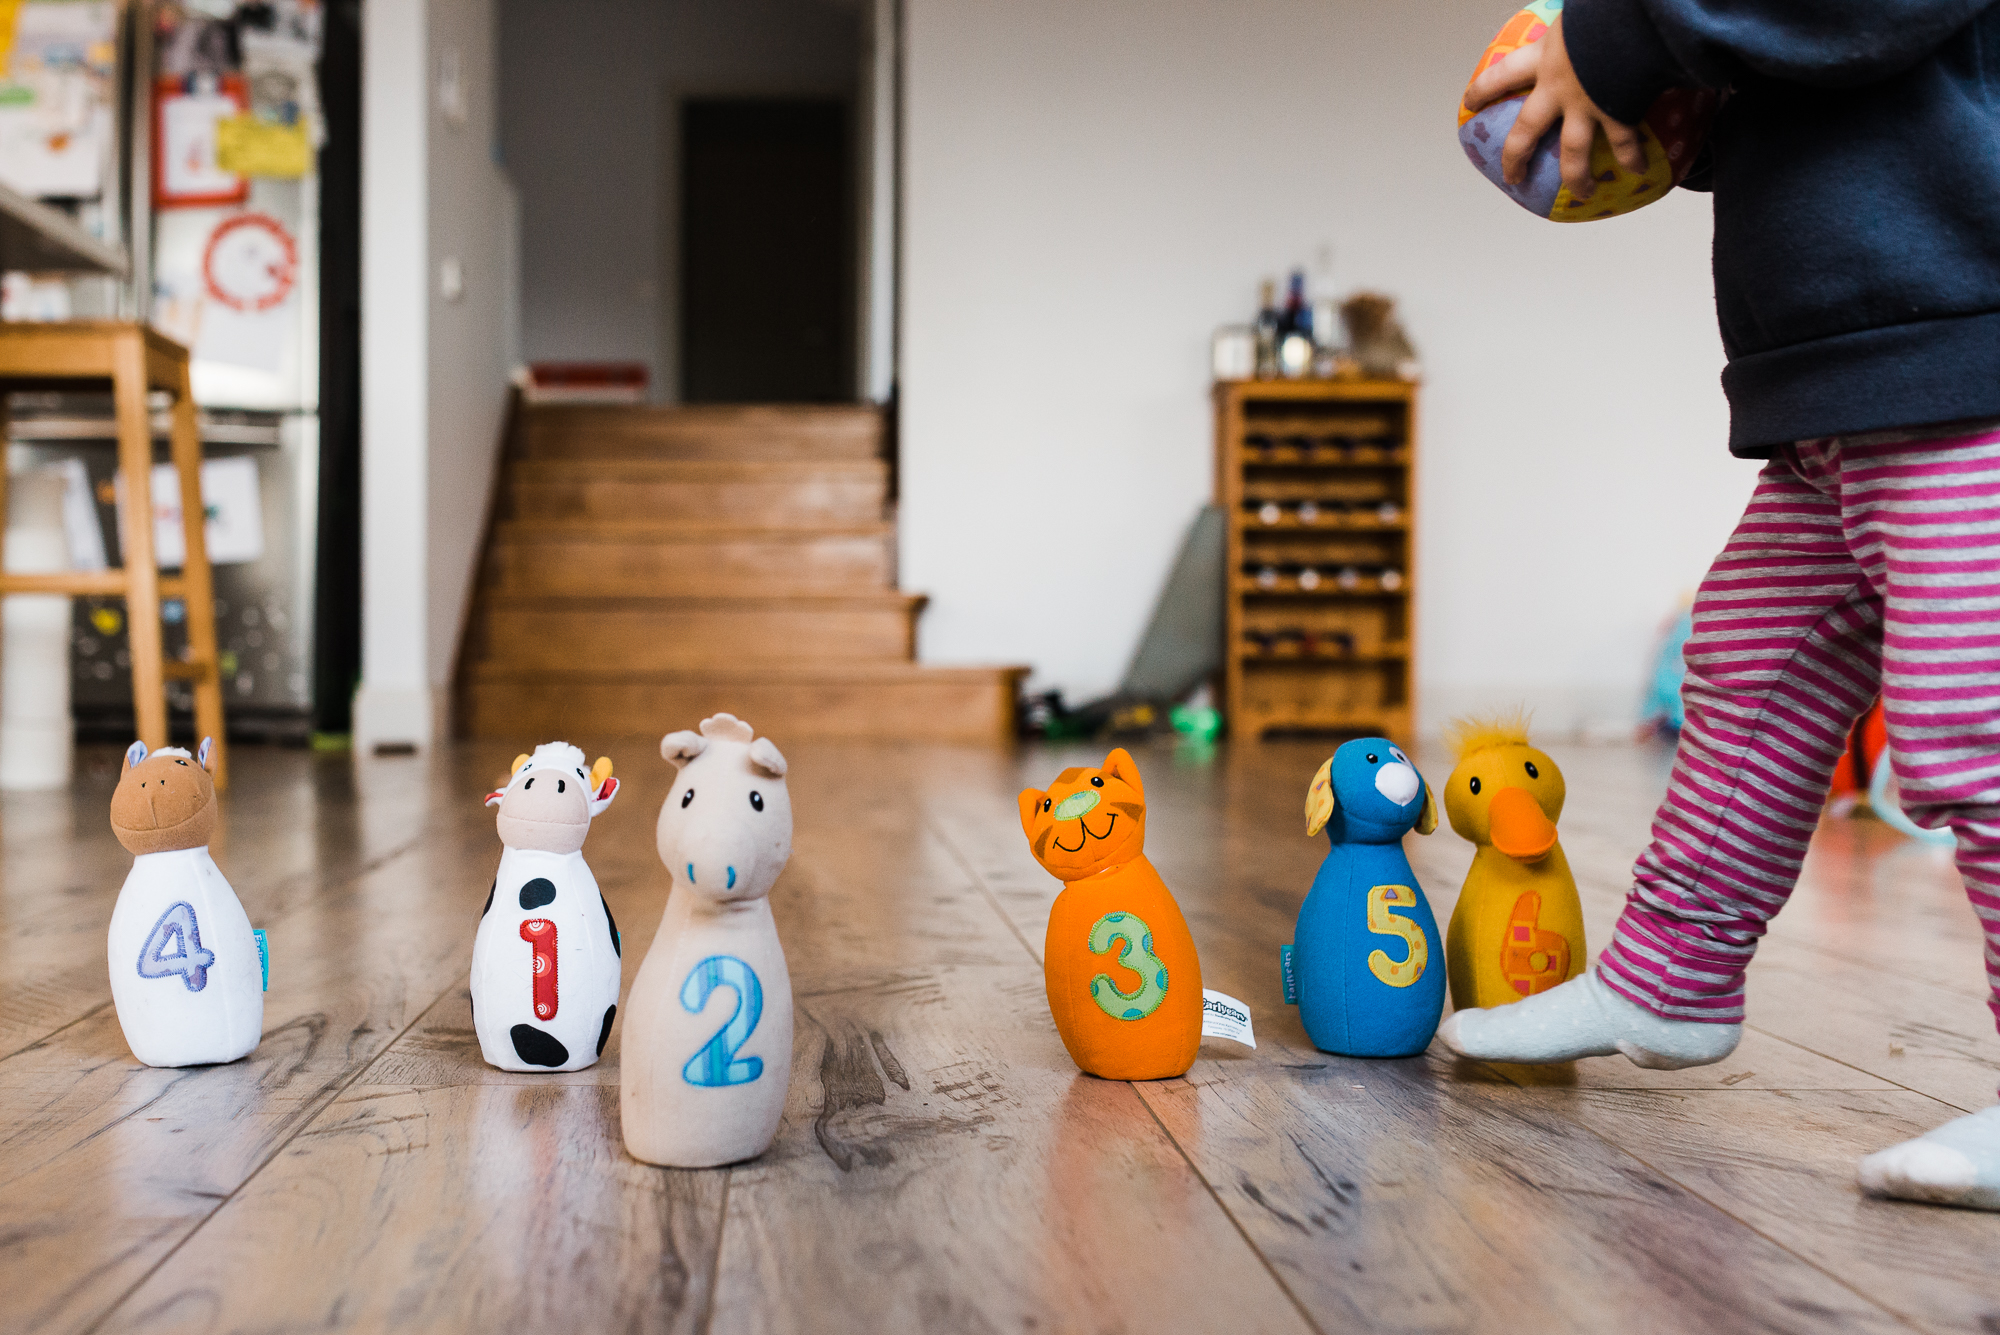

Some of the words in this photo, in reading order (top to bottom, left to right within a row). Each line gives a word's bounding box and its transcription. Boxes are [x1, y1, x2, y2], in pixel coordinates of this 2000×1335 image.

[136, 900, 215, 992] 4
[519, 918, 558, 1021] 1
[1088, 910, 1169, 1021] 3
[1367, 884, 1428, 988] 5
[1500, 889, 1571, 997] 6
[679, 954, 765, 1088] 2
